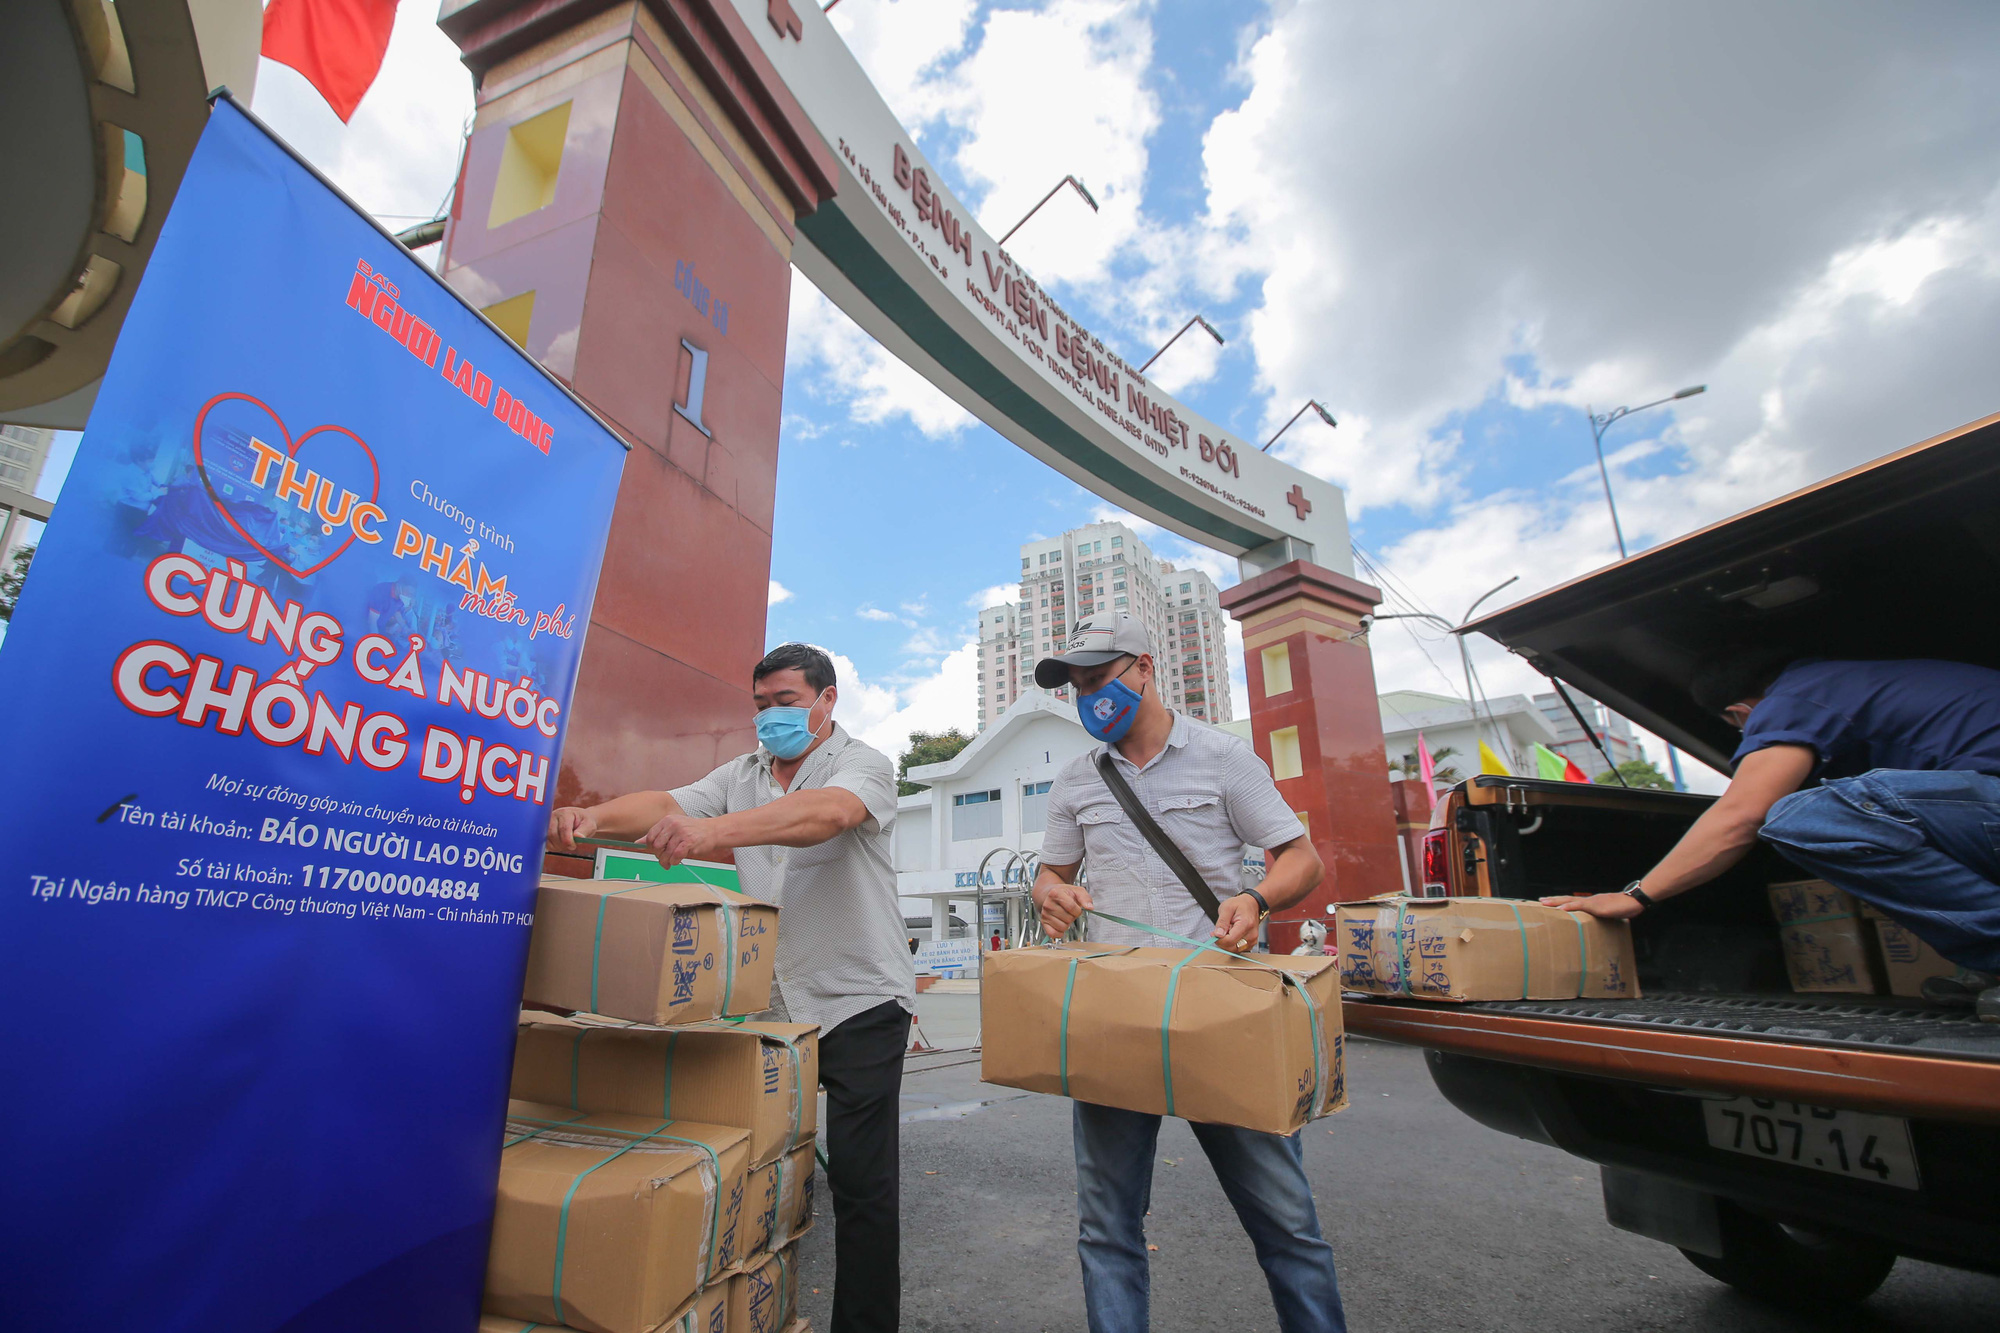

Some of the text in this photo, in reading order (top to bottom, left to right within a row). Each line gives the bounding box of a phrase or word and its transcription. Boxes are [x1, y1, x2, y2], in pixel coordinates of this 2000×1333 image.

[894, 142, 1240, 479] BỆNH VIỆN BỆNH NHIỆT ĐỚI
[345, 271, 554, 456] NGƯỜI LAO ĐỘNG
[673, 337, 711, 439] 1
[966, 278, 1169, 458] HOSPITAL FOR TROPICAL DISEASES (HTD)
[1125, 364, 1146, 387] MINH
[249, 436, 388, 545] THỰC
[392, 538, 508, 604] PHẨM
[410, 479, 515, 554] Chương trình
[144, 552, 560, 738] CÙNG CẢ NƯỚC
[459, 591, 576, 641] miễn phí
[112, 638, 550, 805] CHỐNG DỊCH
[119, 803, 523, 876] Tên tài khoản: BÁO NGƯỜI LAO ĐỘNG
[205, 773, 498, 838] Mọi sự đóng góp xin chuyển vào tài khoản
[30, 875, 66, 902] Tại
[69, 878, 131, 905] Ngân
[136, 883, 190, 910] hàng
[195, 888, 249, 909] TMCP
[252, 893, 296, 916] Công
[299, 896, 357, 919] thương
[361, 901, 391, 920] Việt
[392, 904, 426, 920] Nam
[437, 907, 459, 922] Chi
[460, 909, 499, 925] nhánh
[501, 911, 515, 925] TP
[176, 857, 480, 901] Số tài khoản: 117000004884
[955, 871, 995, 887] KHOA
[1721, 1108, 1891, 1181] 707.14
